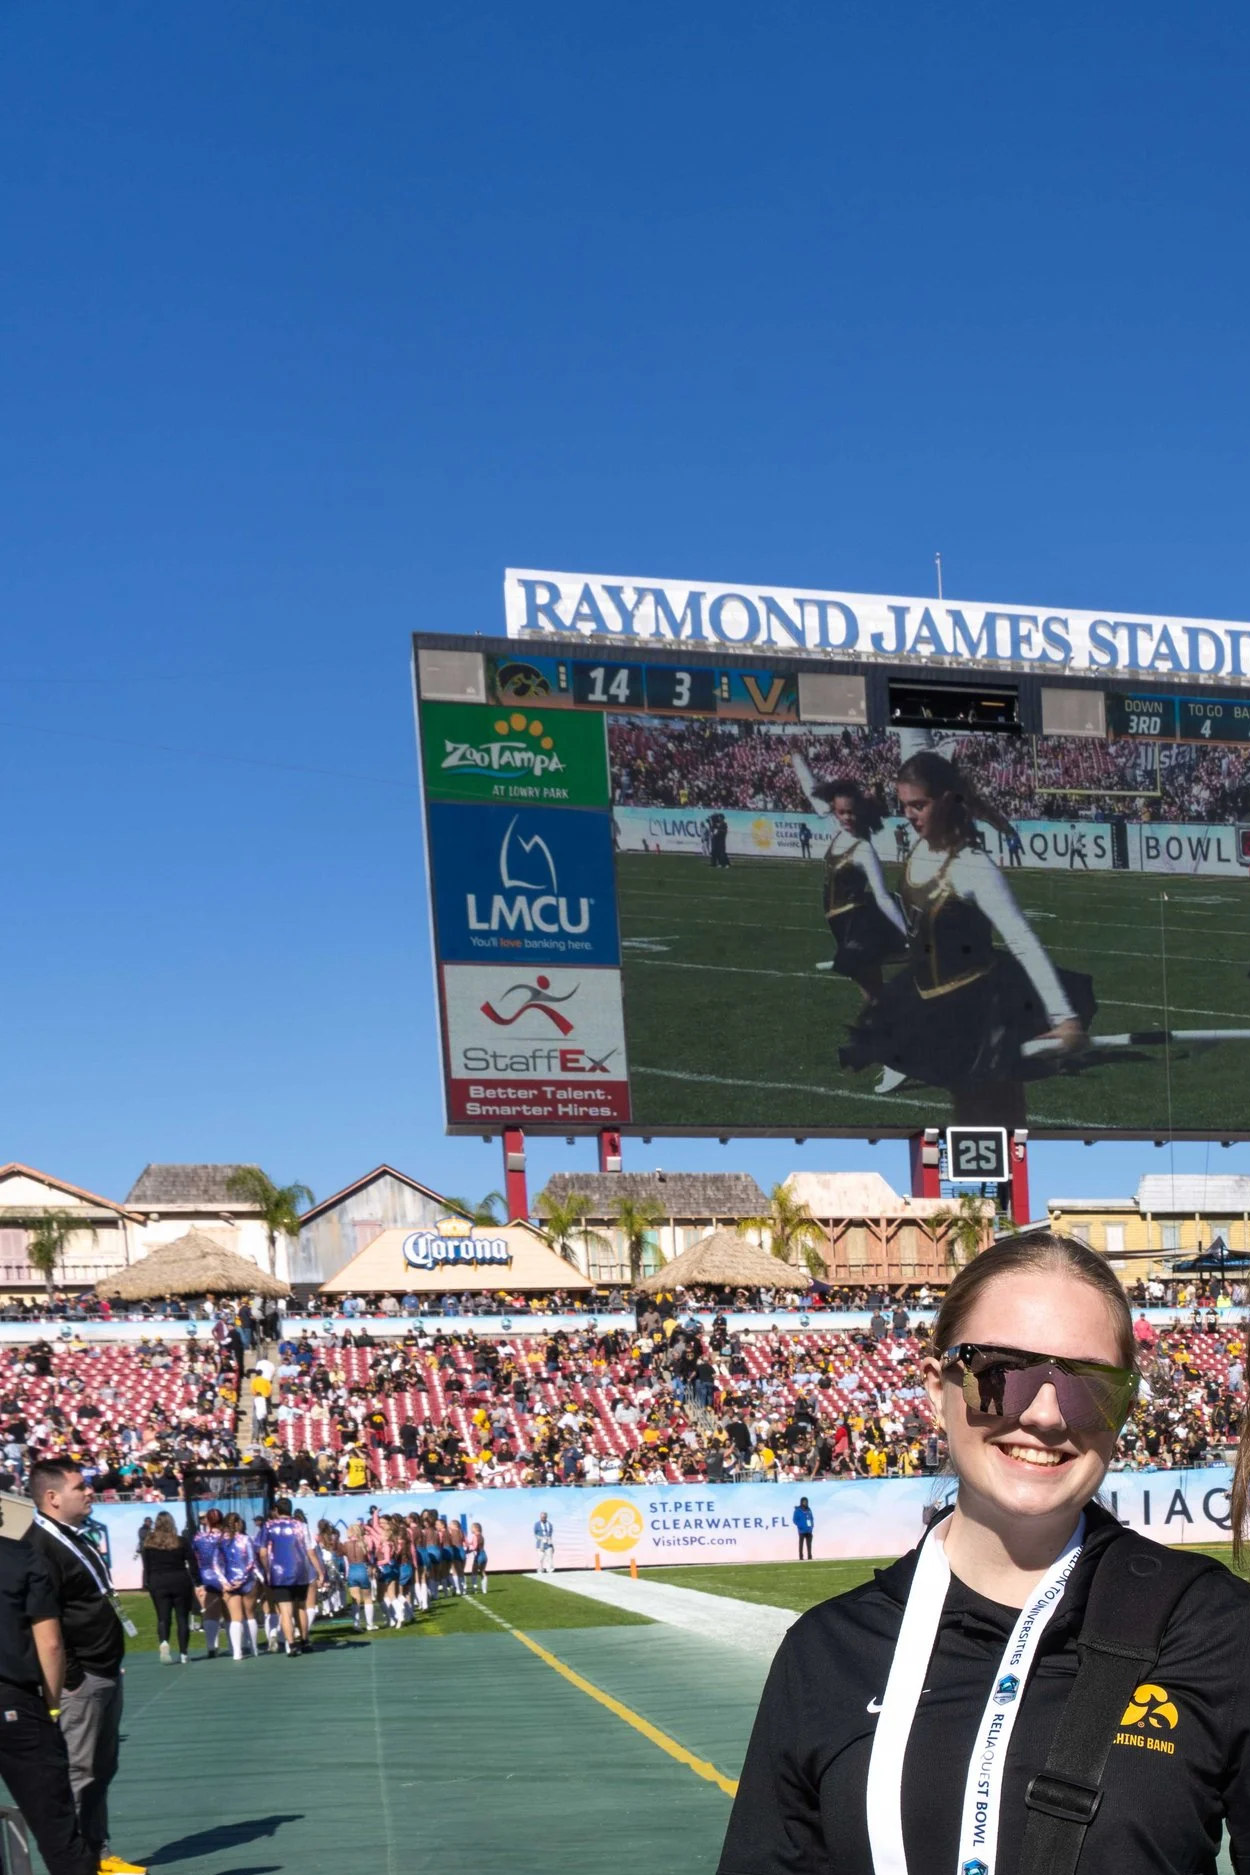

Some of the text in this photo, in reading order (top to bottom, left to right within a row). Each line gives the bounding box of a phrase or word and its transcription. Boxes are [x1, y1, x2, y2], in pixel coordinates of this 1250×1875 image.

[518, 578, 860, 652] RAYMOND
[870, 604, 1071, 664] JAMES
[588, 667, 630, 704] 14
[673, 671, 692, 708] 3
[1124, 699, 1164, 714] DOWN
[1188, 704, 1223, 718] TO GO
[1128, 715, 1161, 735] 3RD
[1200, 718, 1212, 738] 4
[492, 784, 570, 799] AT LOWRY PARK
[1145, 834, 1232, 863] BOWL
[466, 893, 590, 934] LMCU
[524, 938, 566, 952] banking
[469, 1086, 612, 1101] Better Talent.
[466, 1102, 618, 1117] Smarter Hires.
[958, 1140, 998, 1170] 25
[403, 1231, 511, 1269] Corona
[653, 1536, 737, 1547] VisitSPC.com
[1044, 1586, 1061, 1600] TO
[1010, 1599, 1050, 1666] UNIVERSITIES
[978, 1713, 1005, 1797] RELIAQUEST
[1113, 1732, 1175, 1755] HING BAND
[972, 1802, 989, 1847] BOWL
